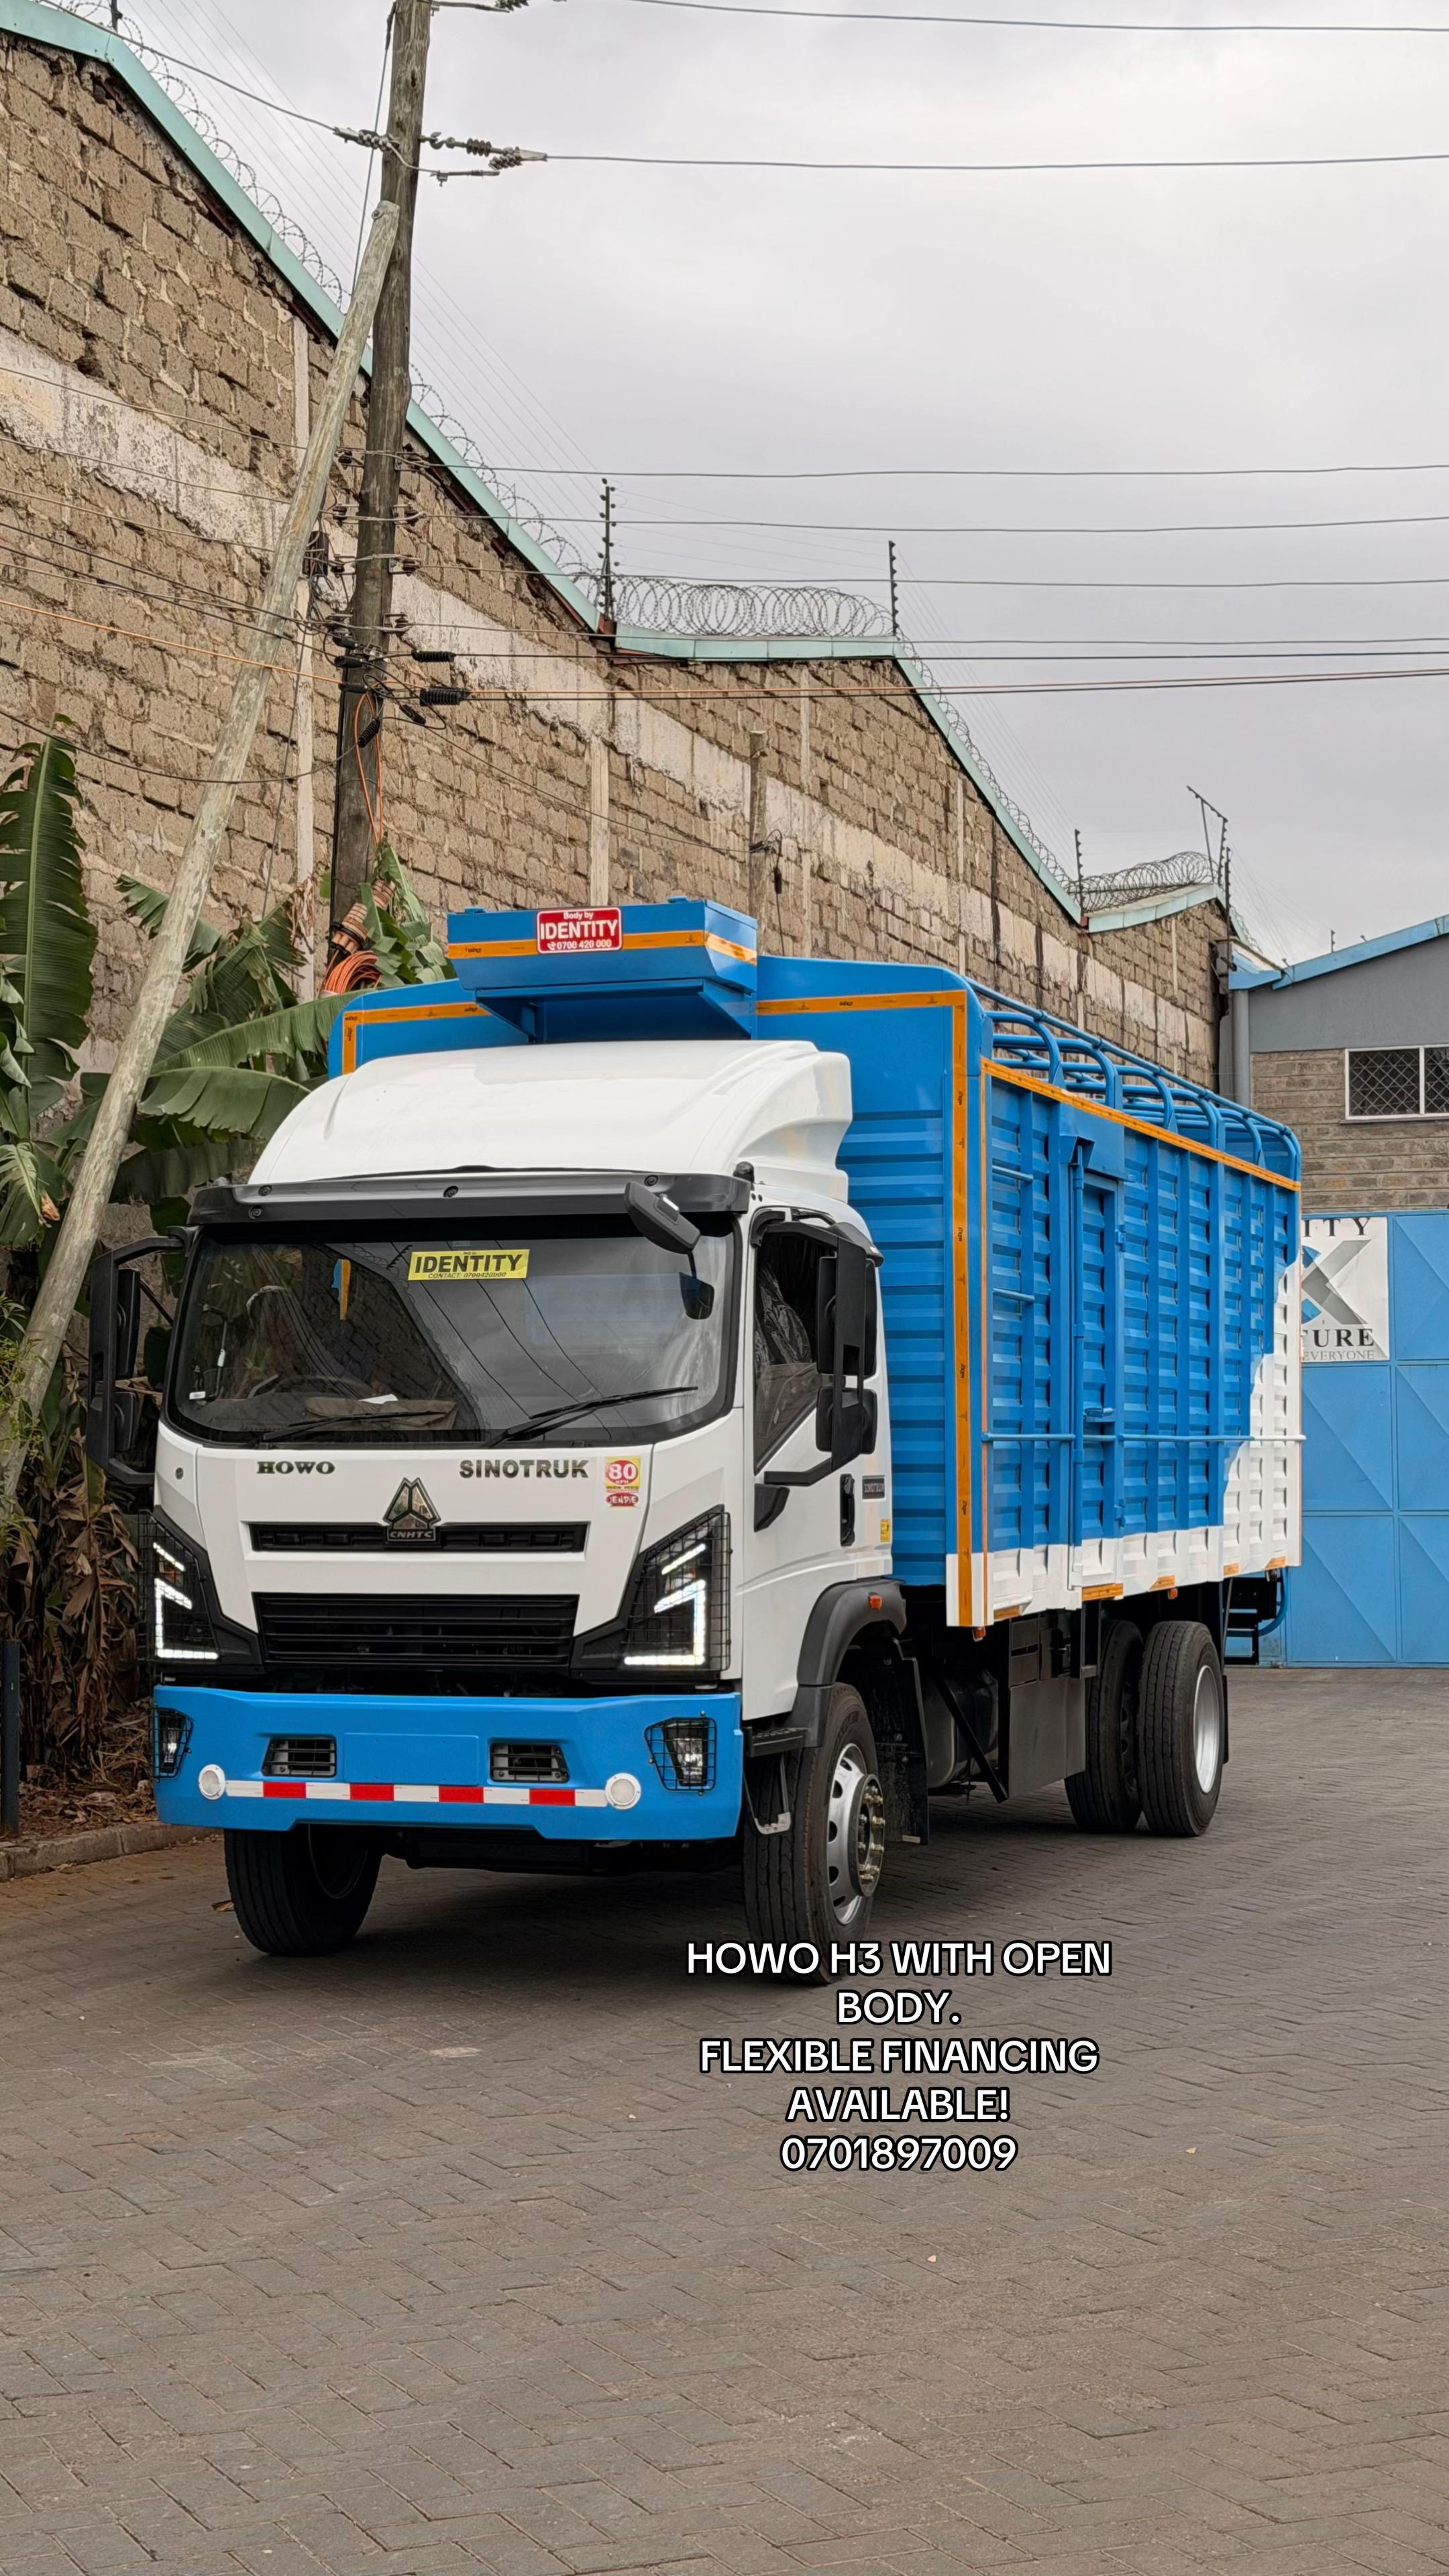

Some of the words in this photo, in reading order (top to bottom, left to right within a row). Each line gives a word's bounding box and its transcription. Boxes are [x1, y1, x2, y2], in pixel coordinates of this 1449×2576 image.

[584, 912, 594, 920] by
[540, 919, 619, 940] IDENTITY
[556, 941, 578, 950] 0700
[578, 940, 594, 949] 420
[415, 1254, 523, 1273] IDENTITY
[1302, 1349, 1375, 1361] EVERYONE
[256, 1460, 336, 1474] HOWO
[459, 1459, 589, 1479] SINOTRUK
[608, 1464, 637, 1480] 80
